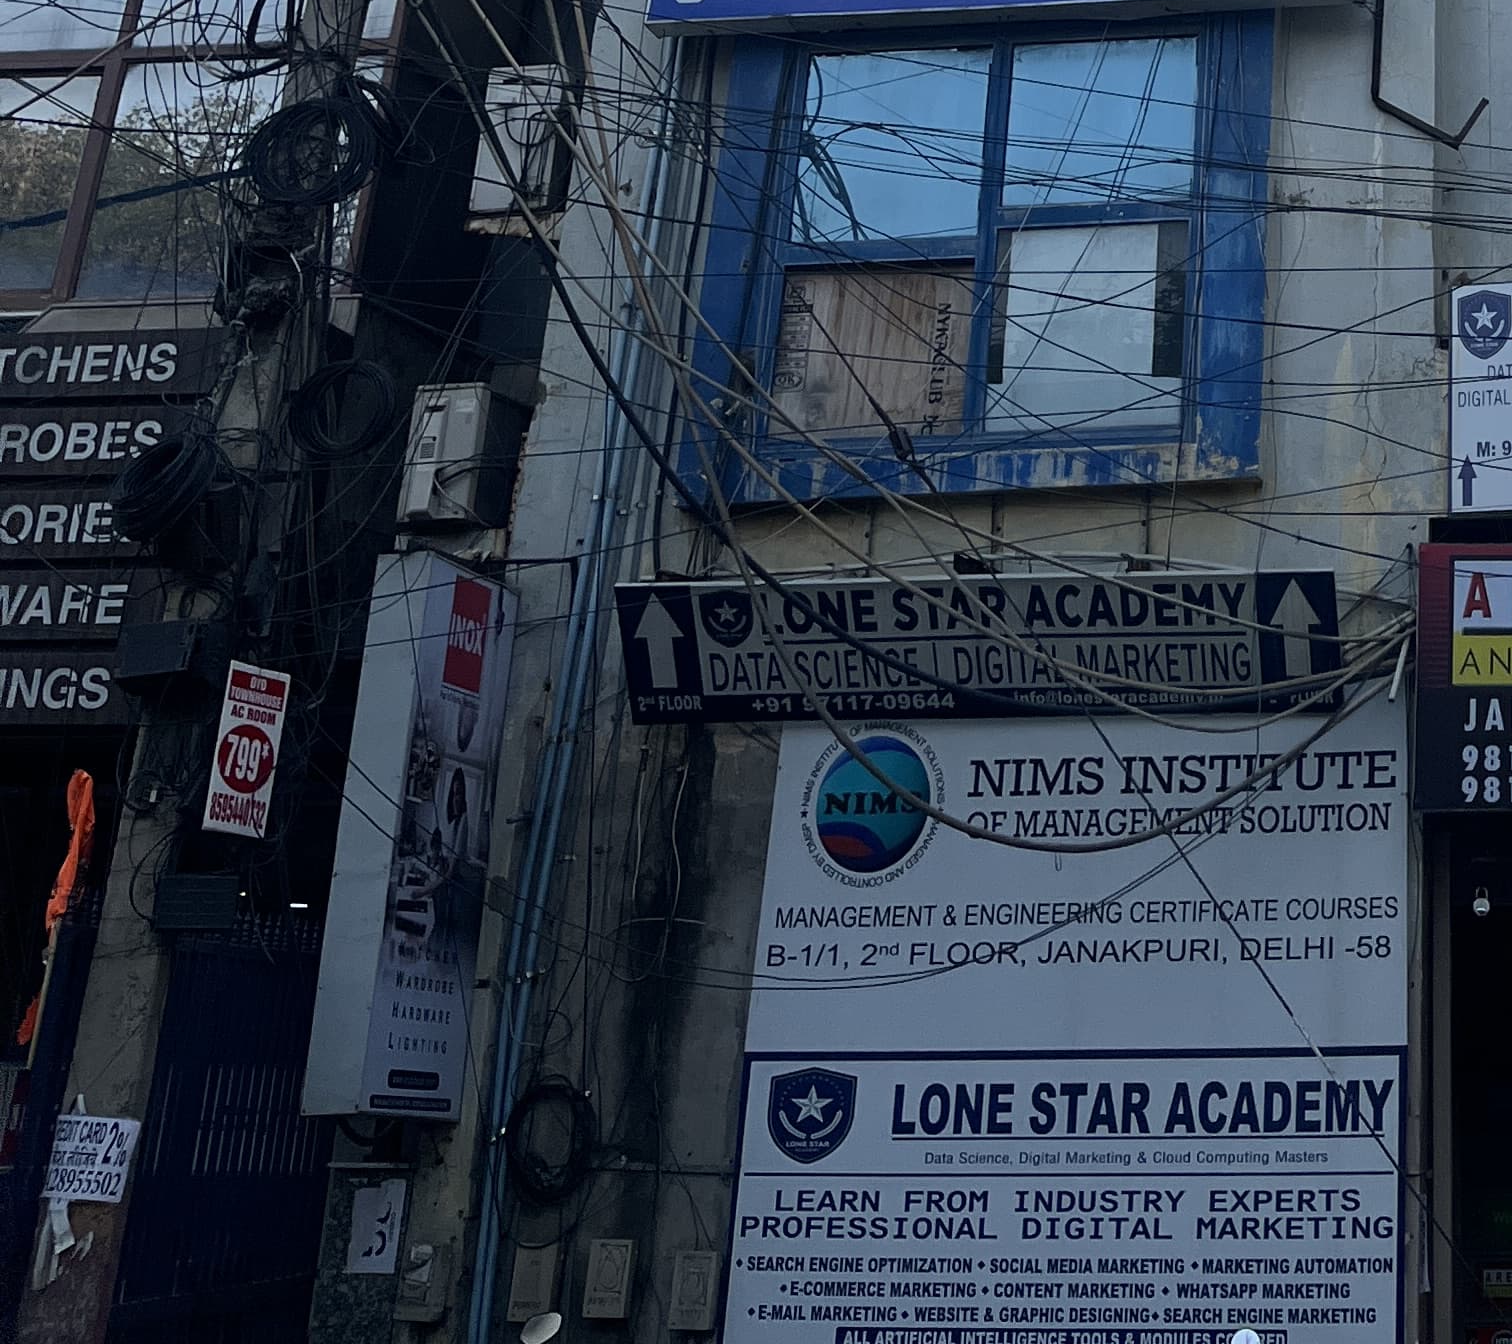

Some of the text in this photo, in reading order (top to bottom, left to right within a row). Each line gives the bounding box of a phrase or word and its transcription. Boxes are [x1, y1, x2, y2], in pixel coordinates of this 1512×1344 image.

[449, 613, 487, 656] INOX
[967, 750, 1397, 798] NIMS INSTITUTE
[775, 896, 1399, 929] MANAGEMENT & ENGINEERING CERTIFICATE COURSES
[892, 1078, 1394, 1135] LONE STAR ACADEMY
[774, 1188, 1361, 1214] LEARN FROM INDUSTRY EXPERTS
